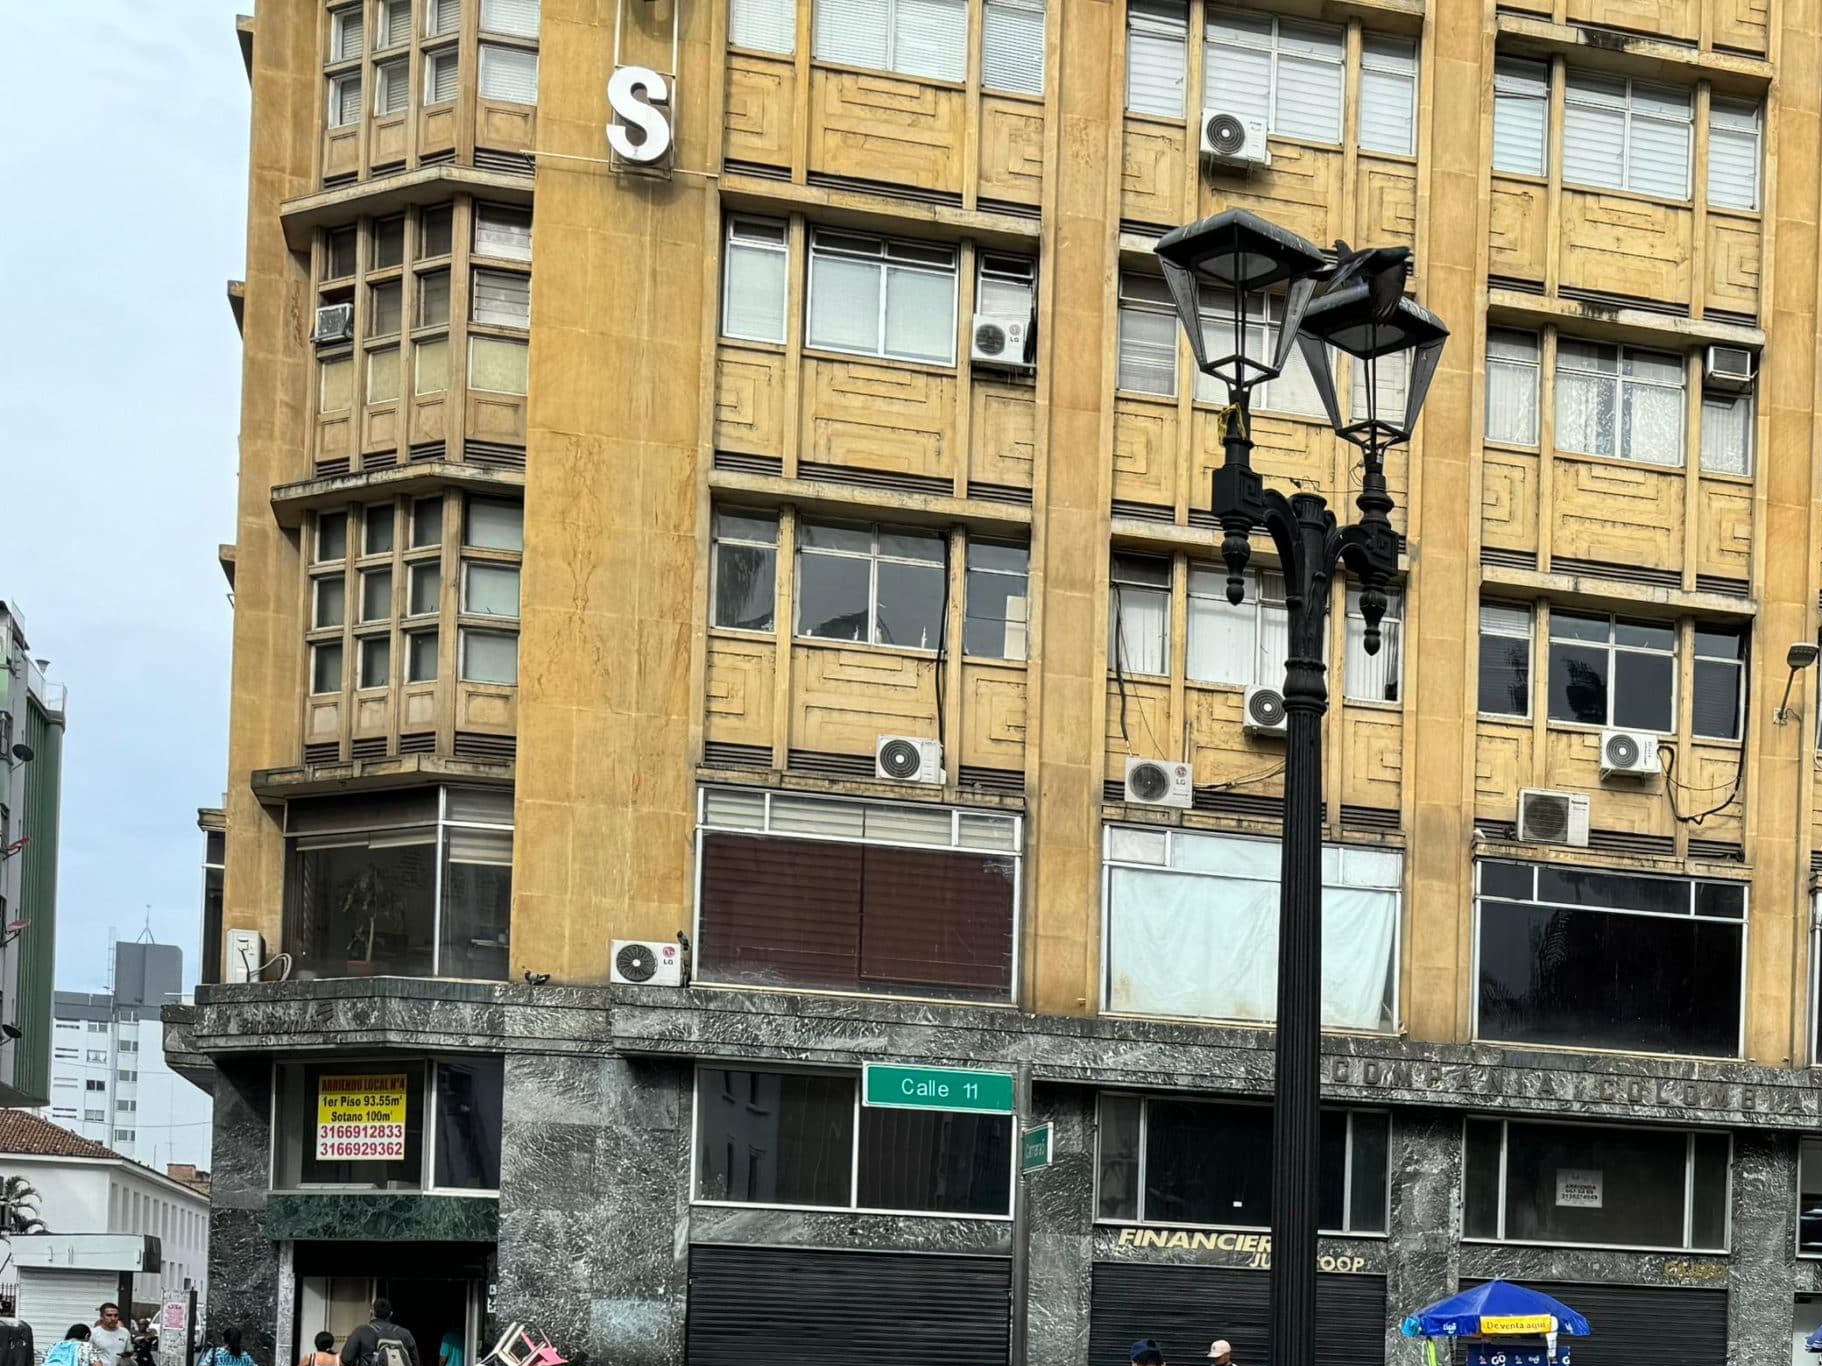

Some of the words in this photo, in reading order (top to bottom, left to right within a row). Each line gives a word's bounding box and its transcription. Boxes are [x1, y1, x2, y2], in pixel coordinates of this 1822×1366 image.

[606, 66, 670, 162] S
[364, 1078, 388, 1091] LOCAL
[901, 1078, 950, 1098] Calle
[963, 1083, 978, 1100] 11
[323, 1096, 338, 1107] 1er
[340, 1096, 361, 1107] Piso
[331, 1111, 363, 1122] Sotano
[320, 1125, 402, 1138] 3166912833
[320, 1142, 403, 1156] 3166929362
[1118, 1228, 1271, 1253] FINANCIER
[1500, 1320, 1525, 1330] venta
